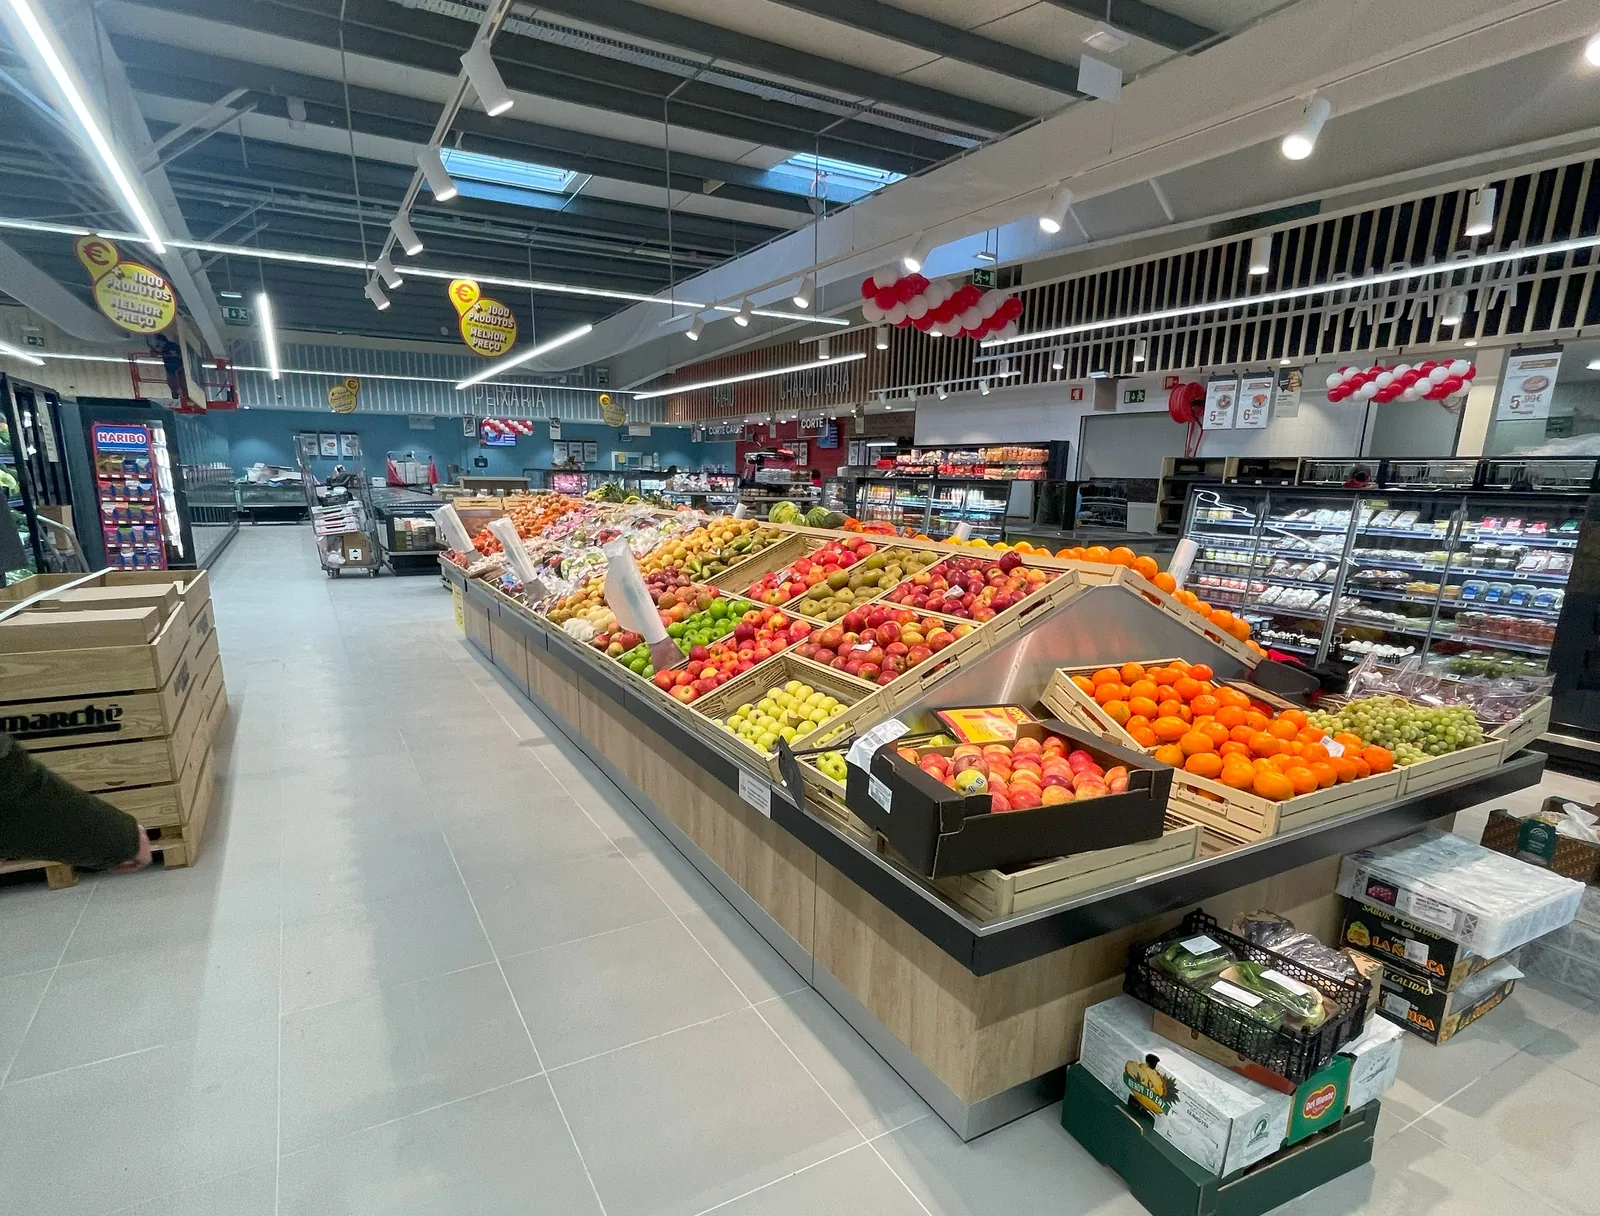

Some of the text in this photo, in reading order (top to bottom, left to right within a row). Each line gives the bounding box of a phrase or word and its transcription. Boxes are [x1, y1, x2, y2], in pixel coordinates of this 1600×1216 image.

[105, 279, 172, 302] PRODUTOS
[133, 272, 165, 290] 1000
[111, 298, 163, 319] MELHOR
[488, 305, 511, 319] 1000
[115, 309, 156, 328] PREÇO
[468, 312, 515, 329] PRODUTOS
[469, 327, 507, 344] MELHOR
[472, 339, 502, 353] PREÇO
[780, 360, 849, 400] CHARCUTARIA
[474, 384, 546, 408] PEIXARIA
[800, 417, 824, 430] CORTE
[98, 432, 147, 444] HARIBO
[1401, 920, 1441, 940] CALIDAD
[1391, 974, 1432, 996] CALIDAD
[1146, 1088, 1154, 1099] TO
[1154, 1097, 1167, 1109] EAT
[1305, 1091, 1335, 1112] Del Monte
